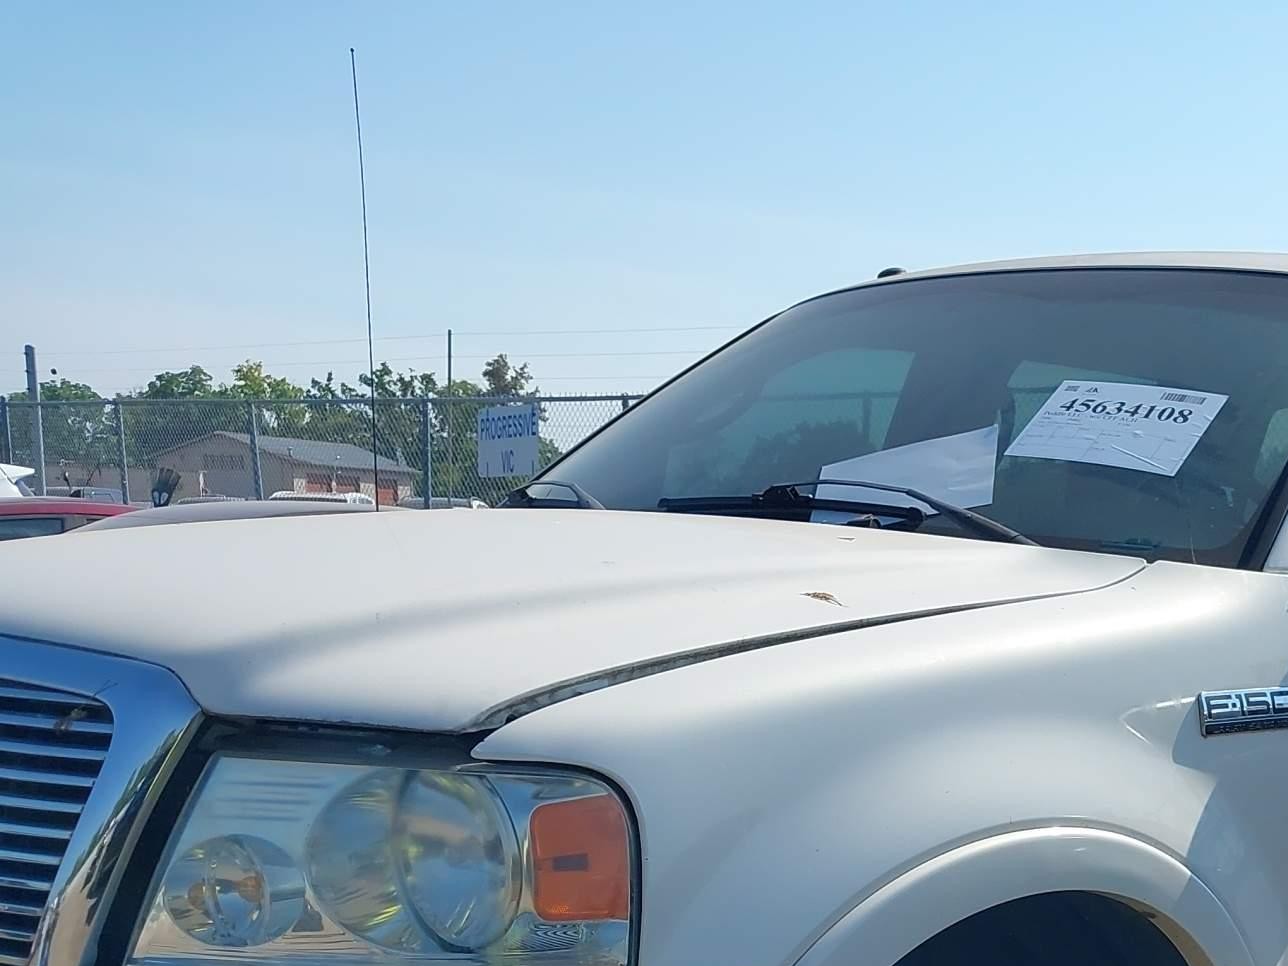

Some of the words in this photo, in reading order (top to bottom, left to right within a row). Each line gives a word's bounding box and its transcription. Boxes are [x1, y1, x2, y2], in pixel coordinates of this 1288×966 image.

[1059, 397, 1193, 424] 45634108
[480, 411, 537, 440] PROGRESSIVE
[501, 449, 515, 473] VIC
